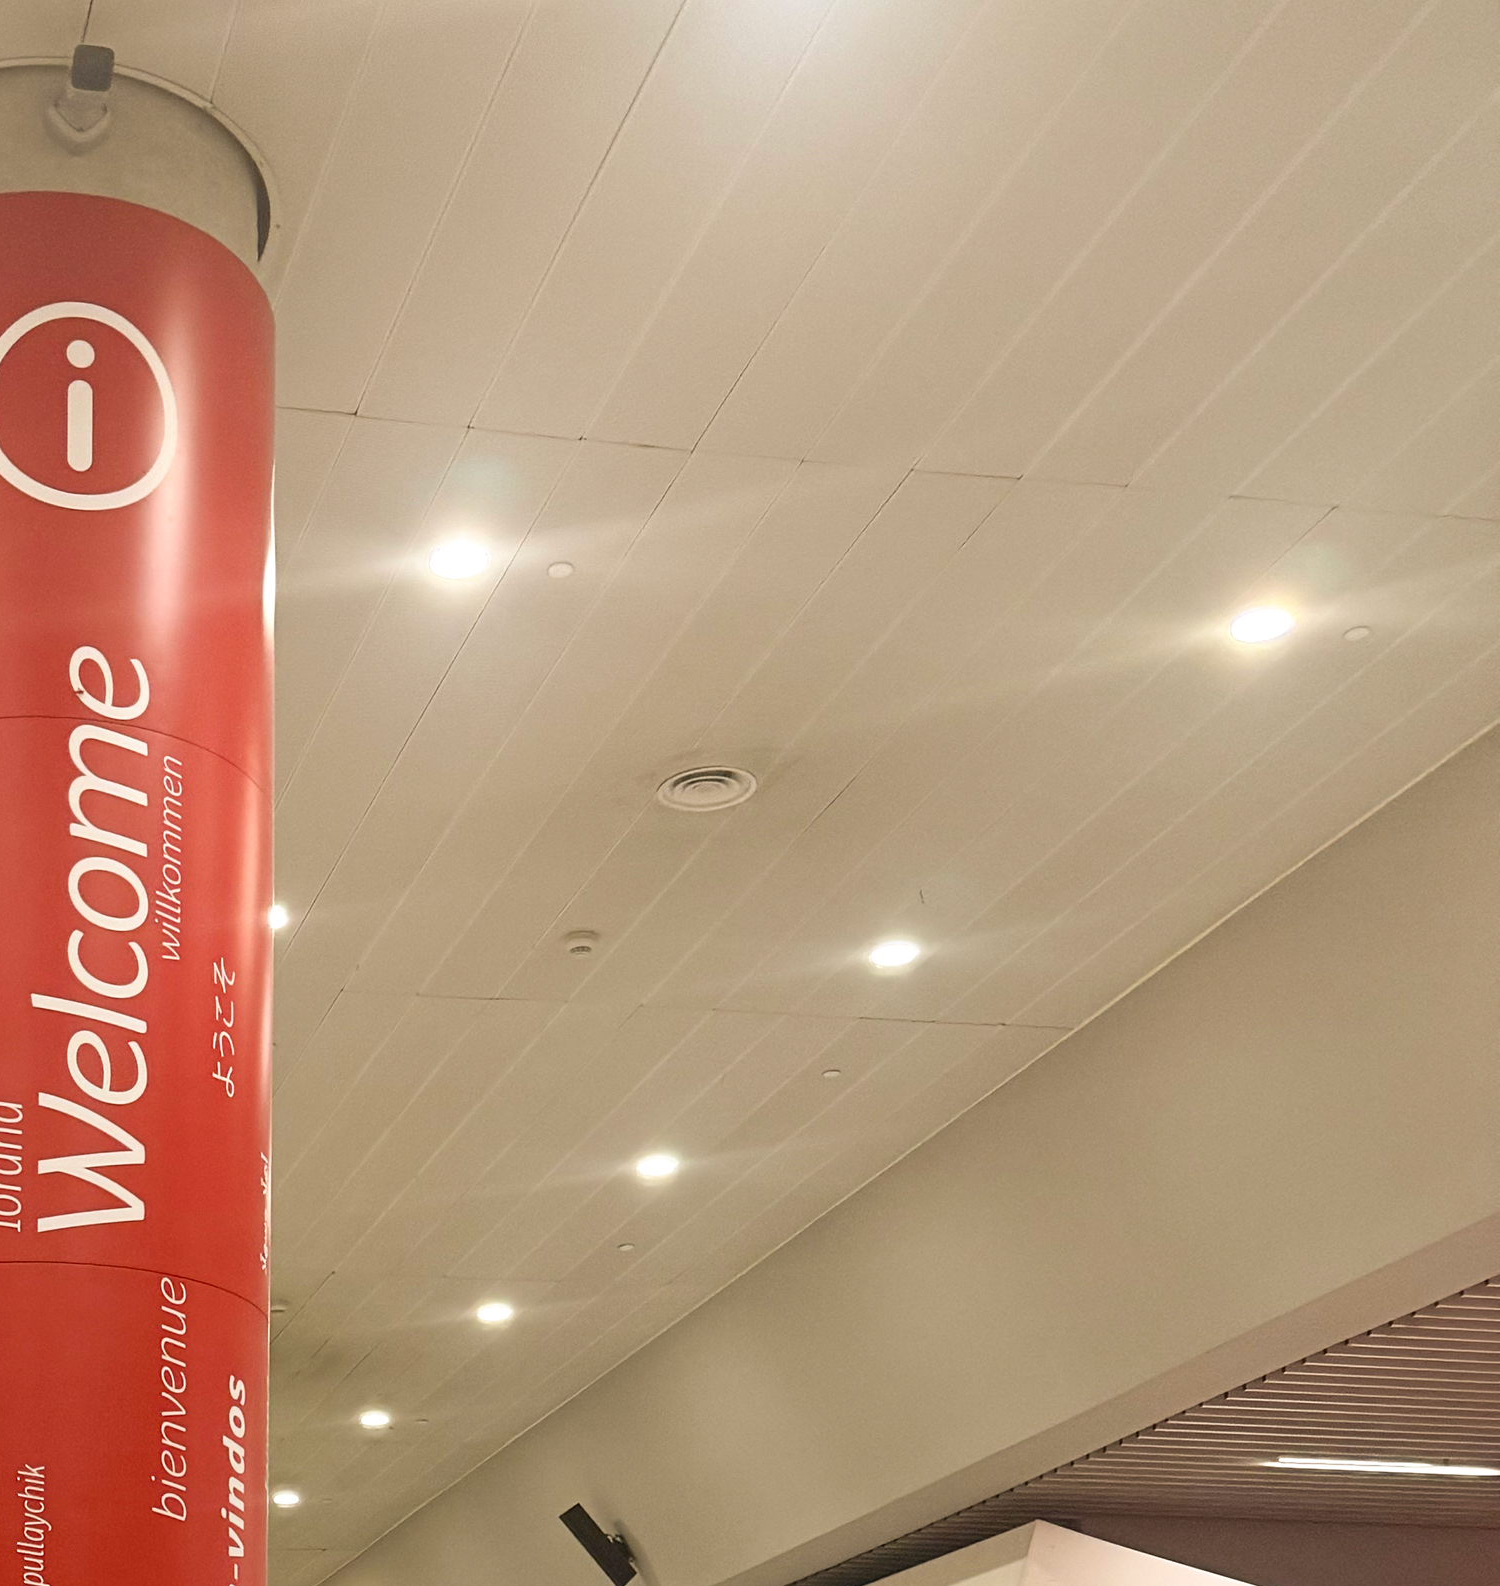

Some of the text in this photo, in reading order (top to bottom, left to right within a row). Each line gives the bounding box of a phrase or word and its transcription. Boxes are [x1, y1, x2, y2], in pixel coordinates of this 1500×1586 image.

[30, 645, 150, 1234] Welcome
[154, 754, 184, 962] willkommen
[212, 956, 237, 1099] ようこそ
[150, 1276, 188, 1523] bienvenue
